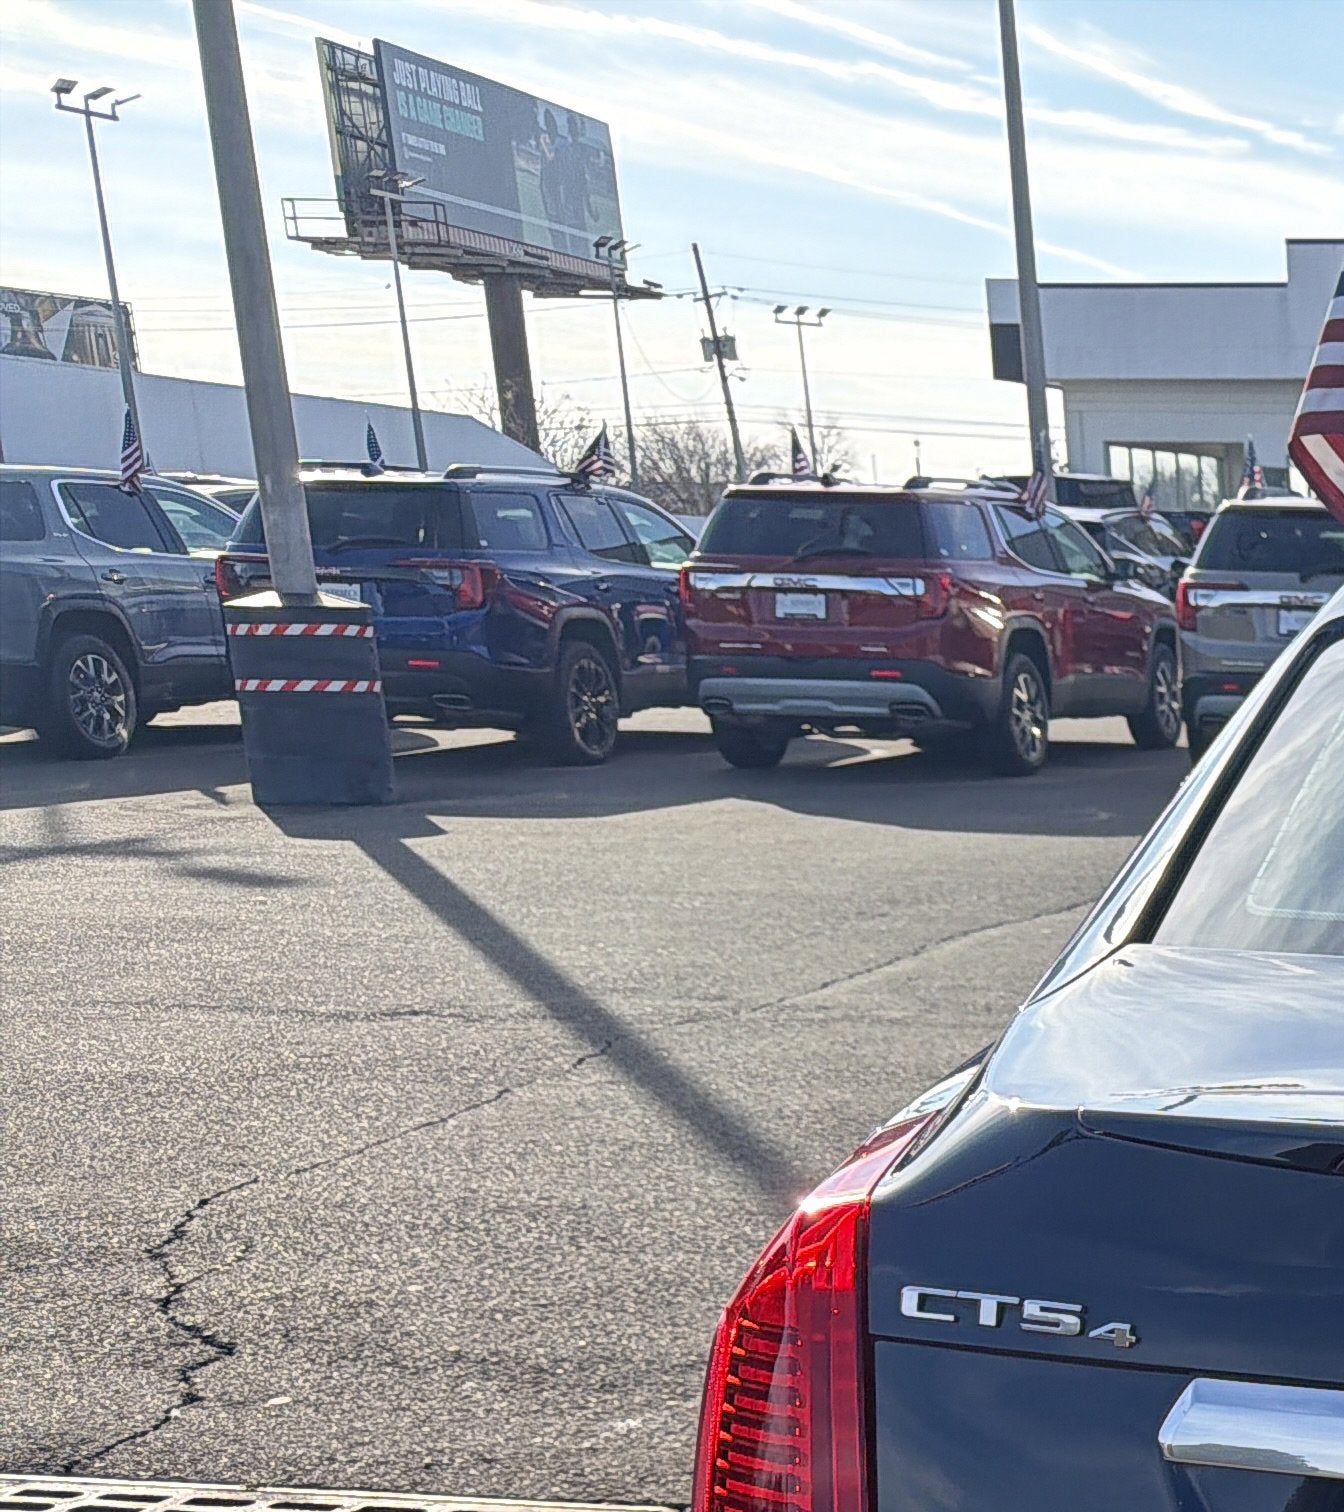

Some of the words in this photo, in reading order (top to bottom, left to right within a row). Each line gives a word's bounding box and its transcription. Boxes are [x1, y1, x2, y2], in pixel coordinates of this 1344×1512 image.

[393, 58, 418, 91] JUST
[418, 66, 460, 105] PLAYING
[459, 81, 483, 112] BALL
